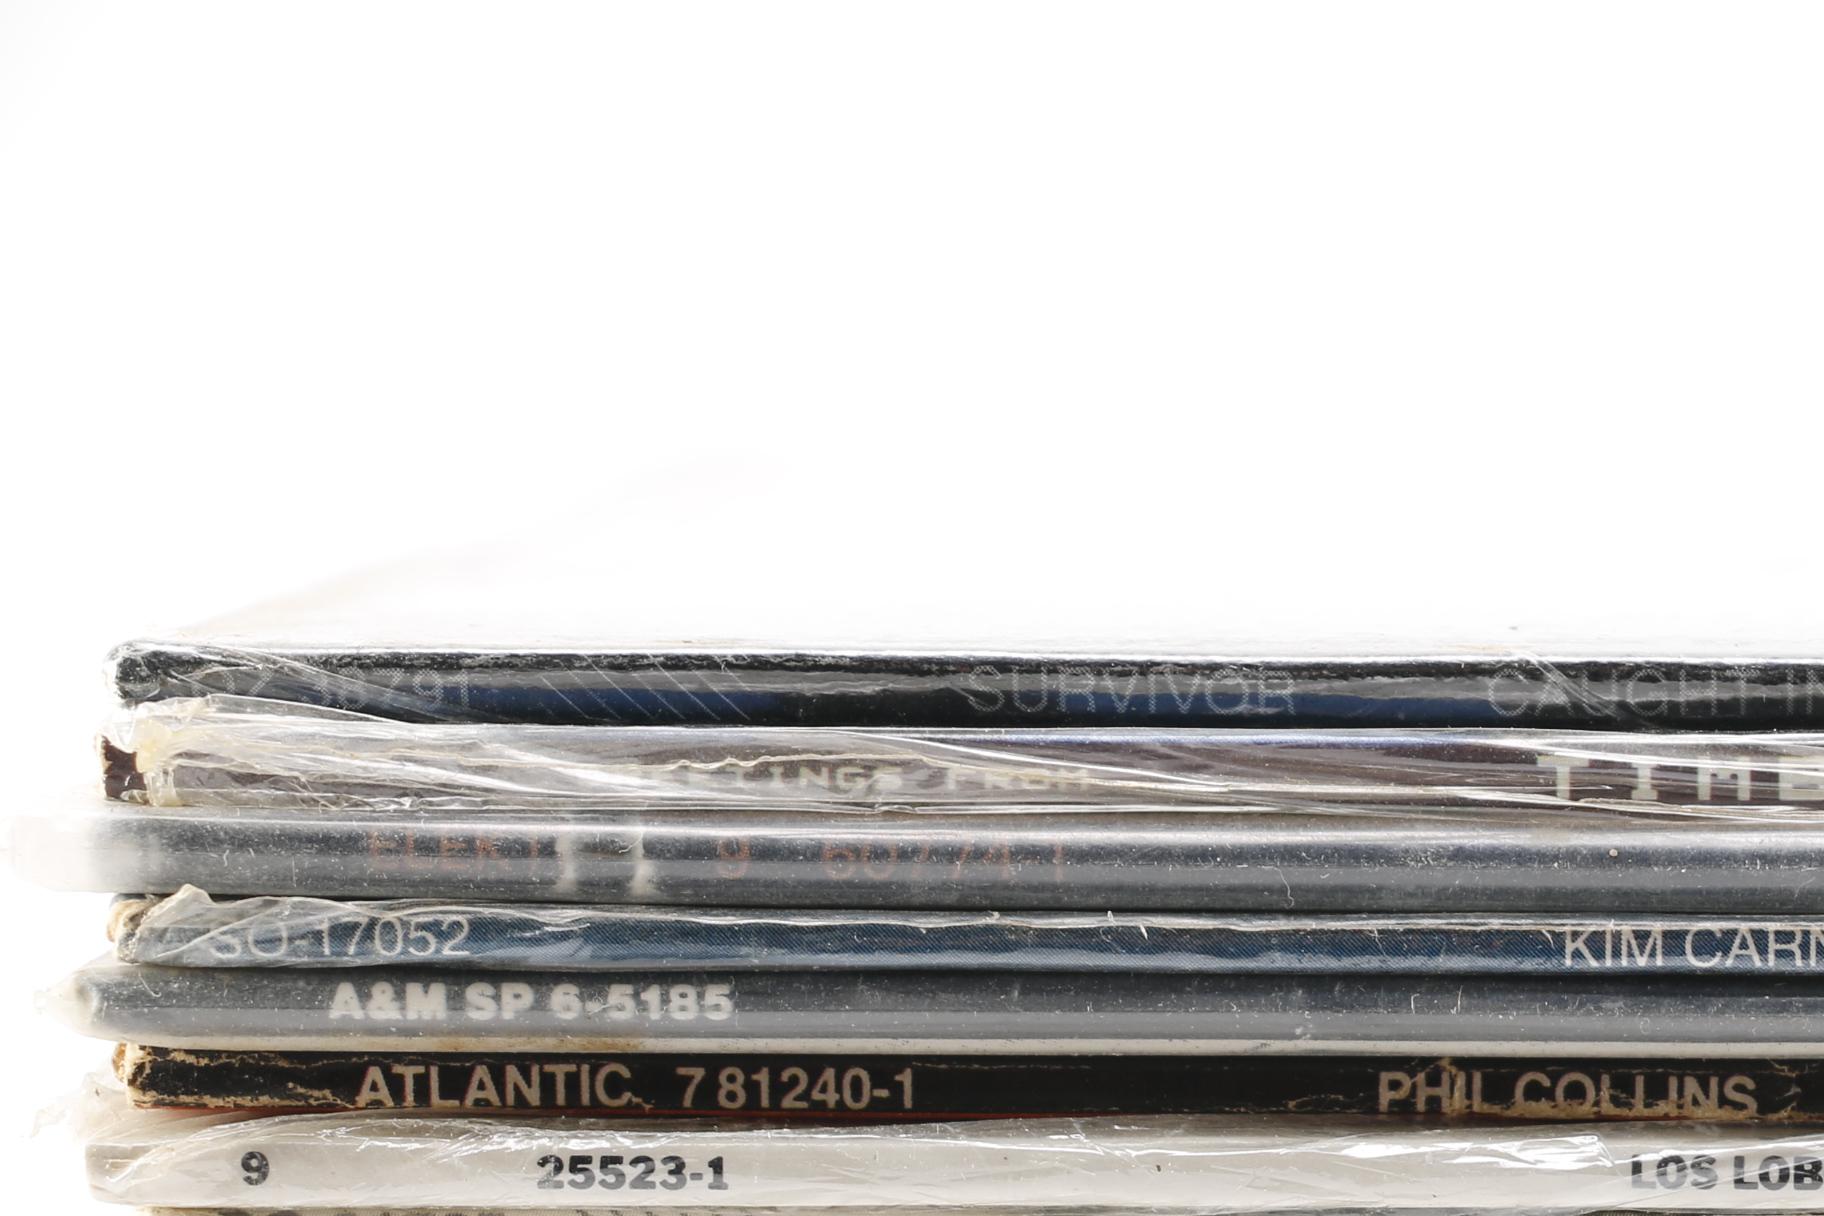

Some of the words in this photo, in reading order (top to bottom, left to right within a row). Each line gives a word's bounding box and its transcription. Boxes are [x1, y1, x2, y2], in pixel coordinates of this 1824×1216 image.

[966, 665, 1296, 715] SURVIVOR
[1487, 667, 1761, 718] CAUGHT
[716, 829, 751, 880] 9
[208, 914, 470, 962] SO-17052
[1563, 926, 1662, 968] KIM
[329, 982, 447, 1020] A&M
[466, 983, 536, 1020] SP
[552, 984, 734, 1021] 6-5185
[355, 1063, 634, 1109] ATLANTIC
[1378, 1070, 1500, 1114] PHIL
[1512, 1070, 1758, 1115] COLLINS
[240, 1151, 270, 1186] 9
[536, 1153, 731, 1191] 25523-1
[1631, 1153, 1718, 1190] LOS
